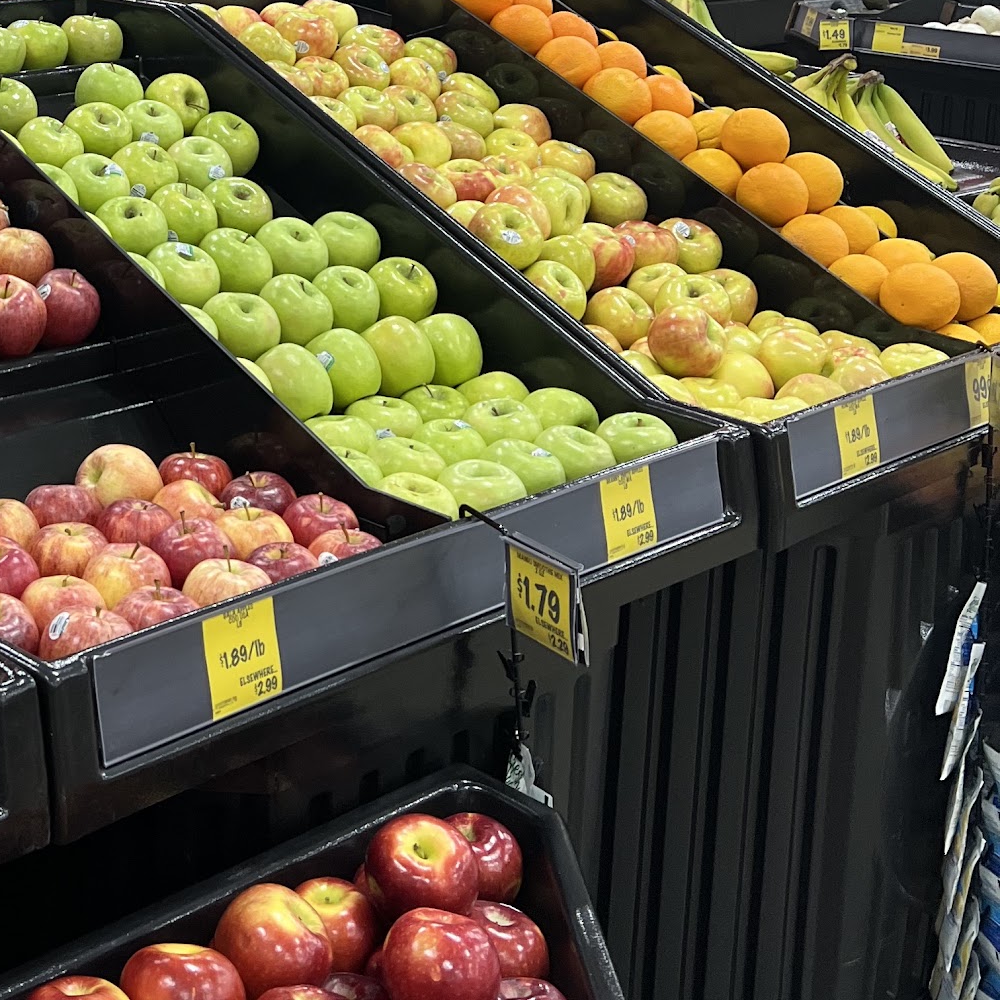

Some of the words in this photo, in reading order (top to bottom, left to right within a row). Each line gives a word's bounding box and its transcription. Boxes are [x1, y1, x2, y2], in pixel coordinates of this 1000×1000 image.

[823, 29, 845, 40] $1.49
[613, 499, 644, 521] $1.89/lb
[637, 530, 654, 546] $2.99
[517, 573, 561, 625] $1.79
[220, 639, 265, 669] $1.89/lb
[254, 676, 278, 696] $2.99
